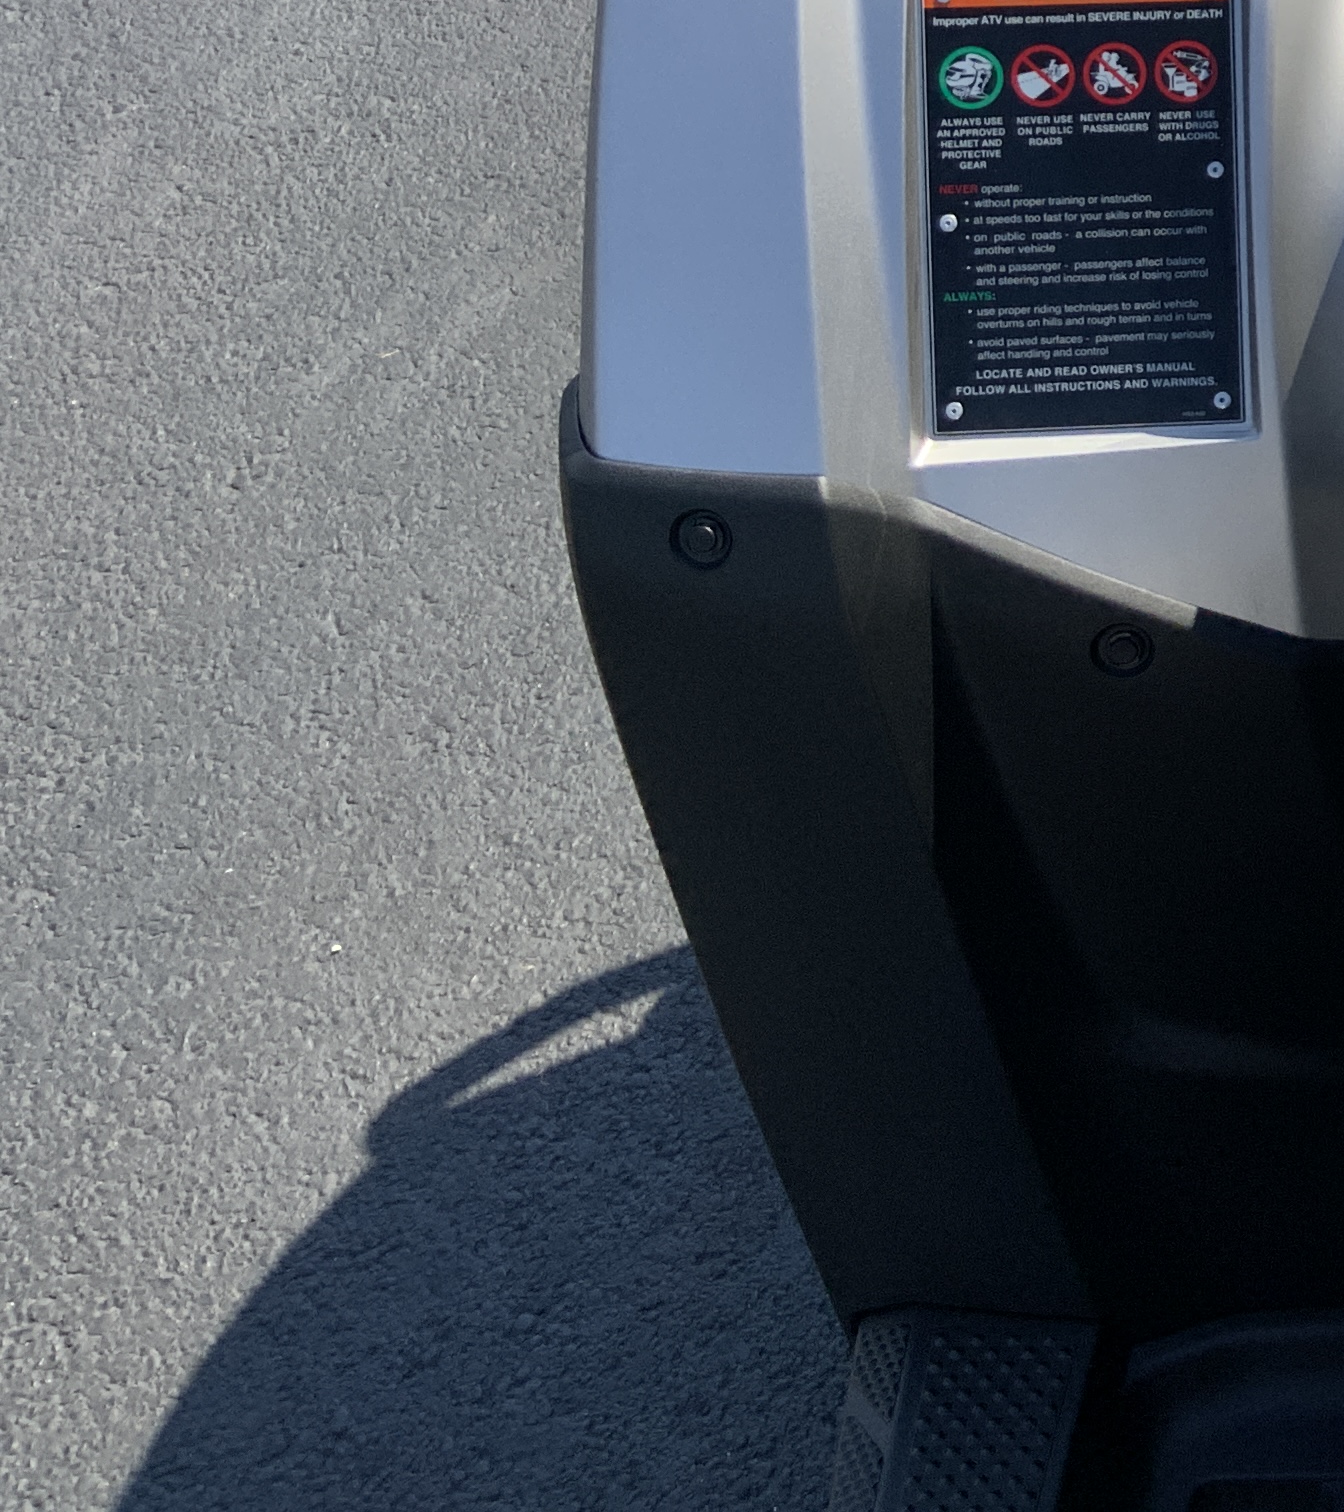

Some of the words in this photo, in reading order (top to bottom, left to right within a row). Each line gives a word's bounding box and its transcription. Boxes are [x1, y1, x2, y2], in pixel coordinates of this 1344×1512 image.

[933, 15, 978, 27] Improper
[981, 15, 1002, 24] ATV
[1045, 13, 1073, 23] result
[1077, 13, 1085, 22] in
[1088, 12, 1130, 22] SEVERE
[1133, 11, 1170, 21] INJURY
[1187, 10, 1222, 19] DEATH
[1017, 115, 1050, 125] NEVER
[1053, 114, 1073, 124] USE
[1080, 112, 1113, 122] NEVER
[1116, 111, 1150, 121] CARRY
[1159, 110, 1191, 120] NEVER
[1194, 109, 1215, 118] USE
[941, 116, 981, 126] ALWAYS
[984, 116, 1002, 125] USE
[1159, 121, 1182, 130] WITH
[1185, 120, 1219, 130] DRUGS
[937, 128, 950, 137] AN
[952, 126, 1005, 137] APPROVED
[1018, 126, 1031, 136] ON
[1035, 124, 1073, 135] PUBLIC
[1083, 122, 1149, 133] PASSENGERS
[1029, 136, 1062, 146] ROADS
[1158, 132, 1172, 141] OR
[1174, 130, 1220, 141] ALCOHOL
[940, 138, 978, 148] HELMET
[981, 138, 1002, 147] AND
[942, 148, 1001, 160] PROTECTIVE
[960, 160, 987, 170] GEAR
[939, 184, 976, 194] NEVER
[975, 198, 1010, 208] without
[1013, 198, 1045, 208] proper
[1048, 195, 1084, 207] training
[1101, 193, 1151, 204] instruction
[944, 292, 996, 302] ALWAYS:
[976, 368, 1022, 379] LOCATE
[1026, 367, 1051, 378] AND
[1054, 366, 1087, 376] READ
[1090, 364, 1143, 375] OWNER'S
[1147, 362, 1195, 373] MANUAL
[956, 384, 1005, 395] FOLLOW
[1008, 383, 1030, 393] ALL
[1034, 380, 1120, 392] INSTRUCTIONS
[1124, 379, 1148, 389] AND
